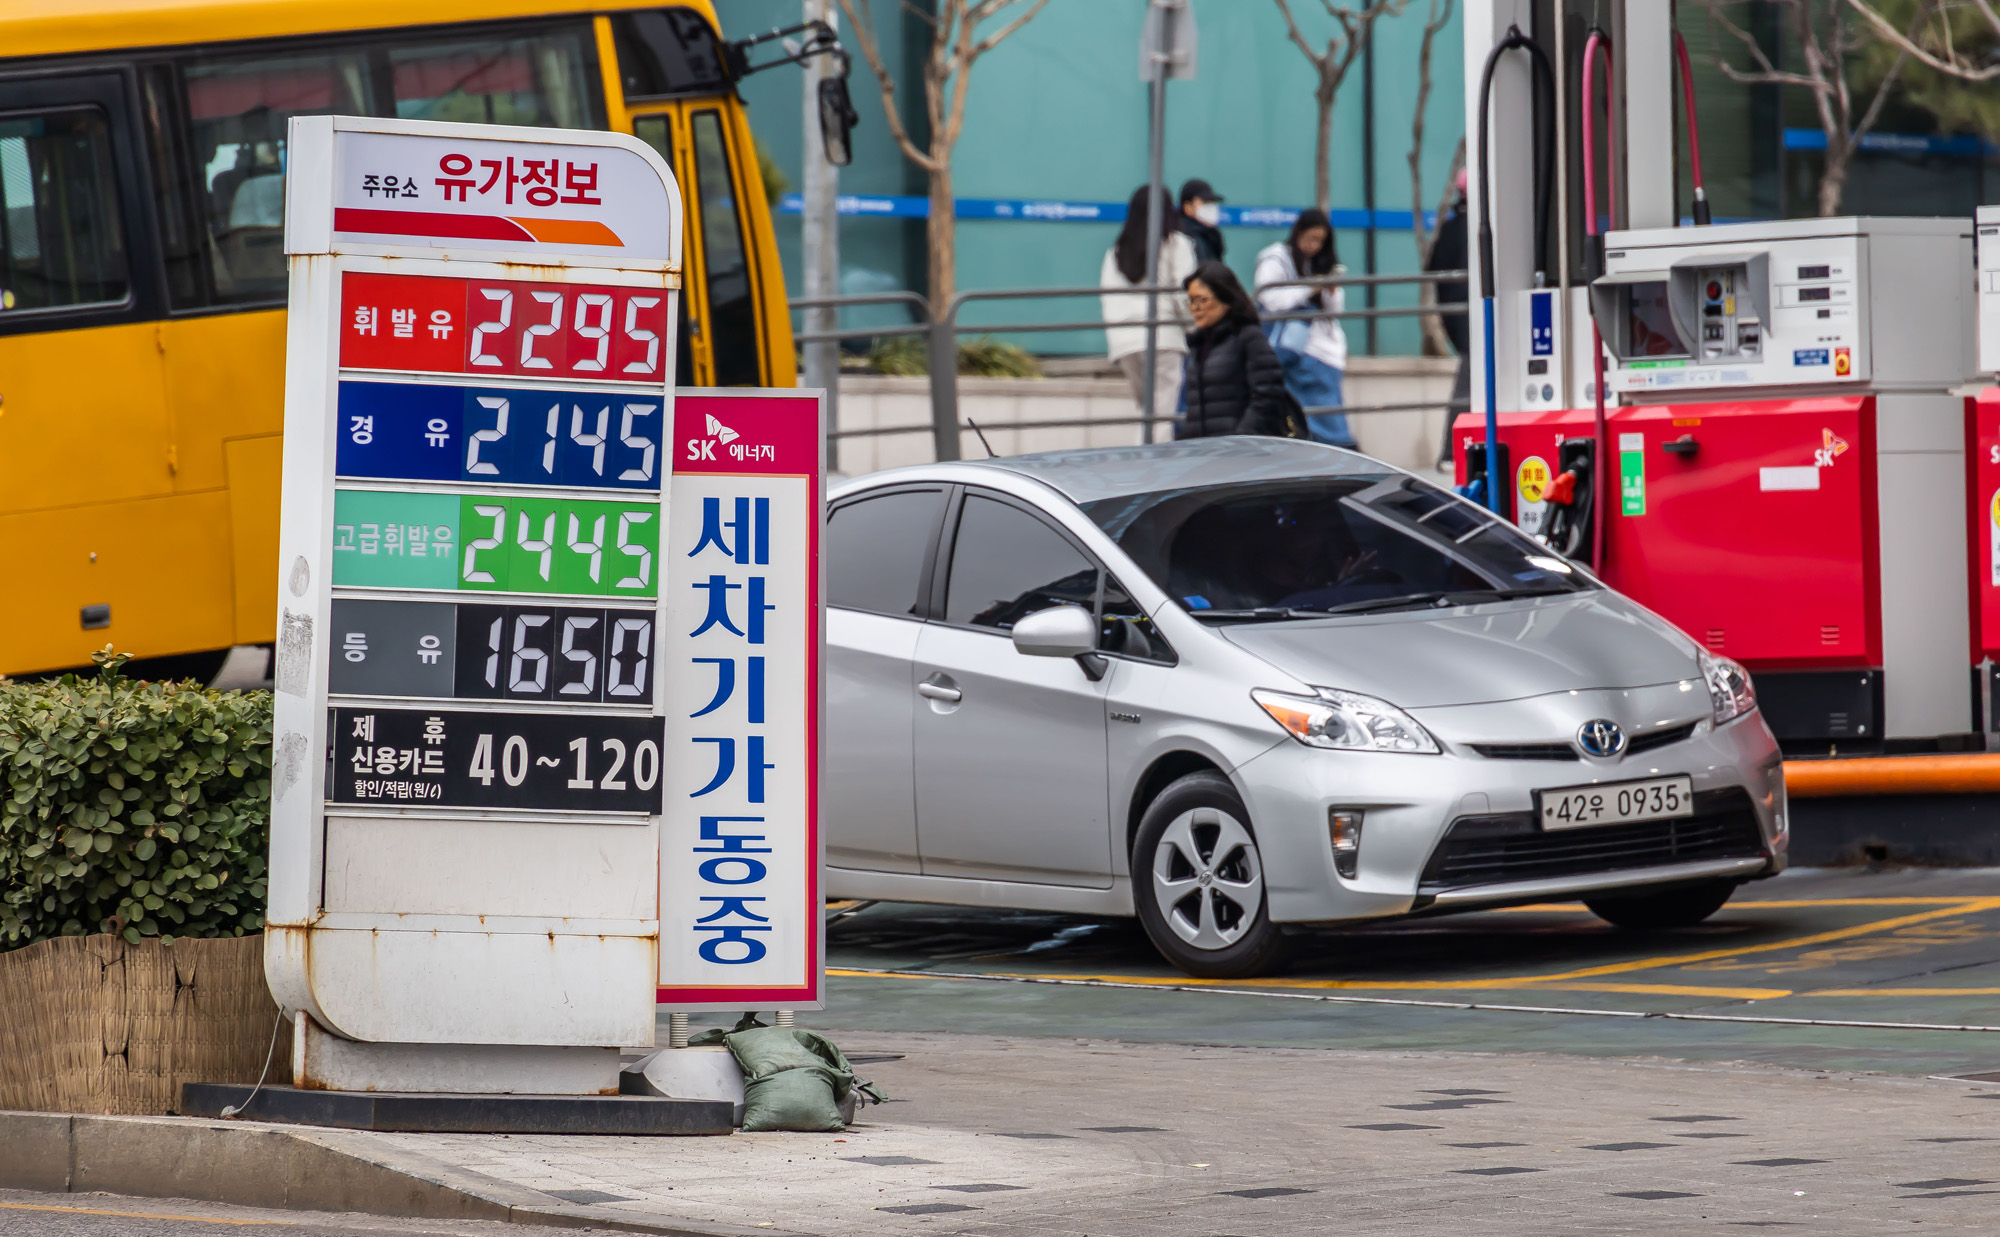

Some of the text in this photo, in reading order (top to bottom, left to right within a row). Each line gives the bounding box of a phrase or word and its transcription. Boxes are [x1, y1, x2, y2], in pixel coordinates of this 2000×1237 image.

[362, 153, 602, 207] 주유소 유가정보
[469, 288, 662, 374] 2295
[466, 396, 658, 481] 2145
[687, 439, 775, 462] SK 에너지
[1814, 448, 1834, 467] SK
[333, 504, 655, 589] 고급휘발유 2445
[484, 613, 651, 697] 1650
[351, 746, 445, 775] 신용카드
[1557, 784, 1679, 822] 42우 0935
